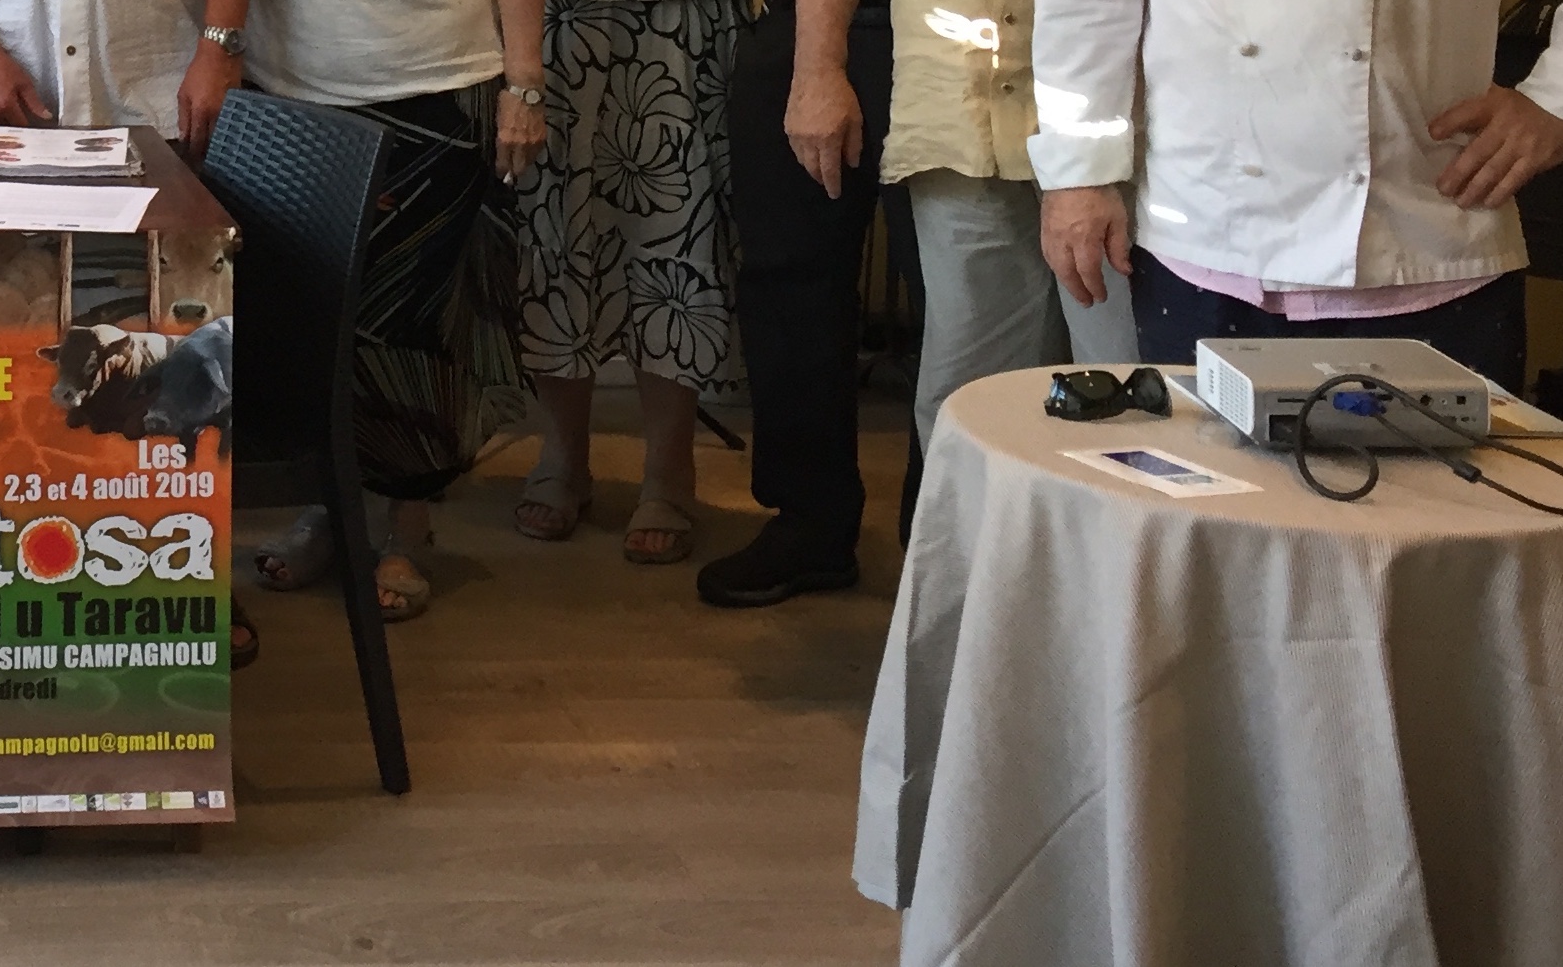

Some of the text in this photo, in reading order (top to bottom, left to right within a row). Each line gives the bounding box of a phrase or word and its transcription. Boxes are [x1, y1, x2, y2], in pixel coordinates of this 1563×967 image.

[138, 439, 186, 469] Les
[4, 471, 214, 504] 2,3 et 4 août 2019
[16, 600, 43, 639] u
[57, 591, 216, 638] Taravu
[64, 642, 217, 669] CAMPAGNOLU
